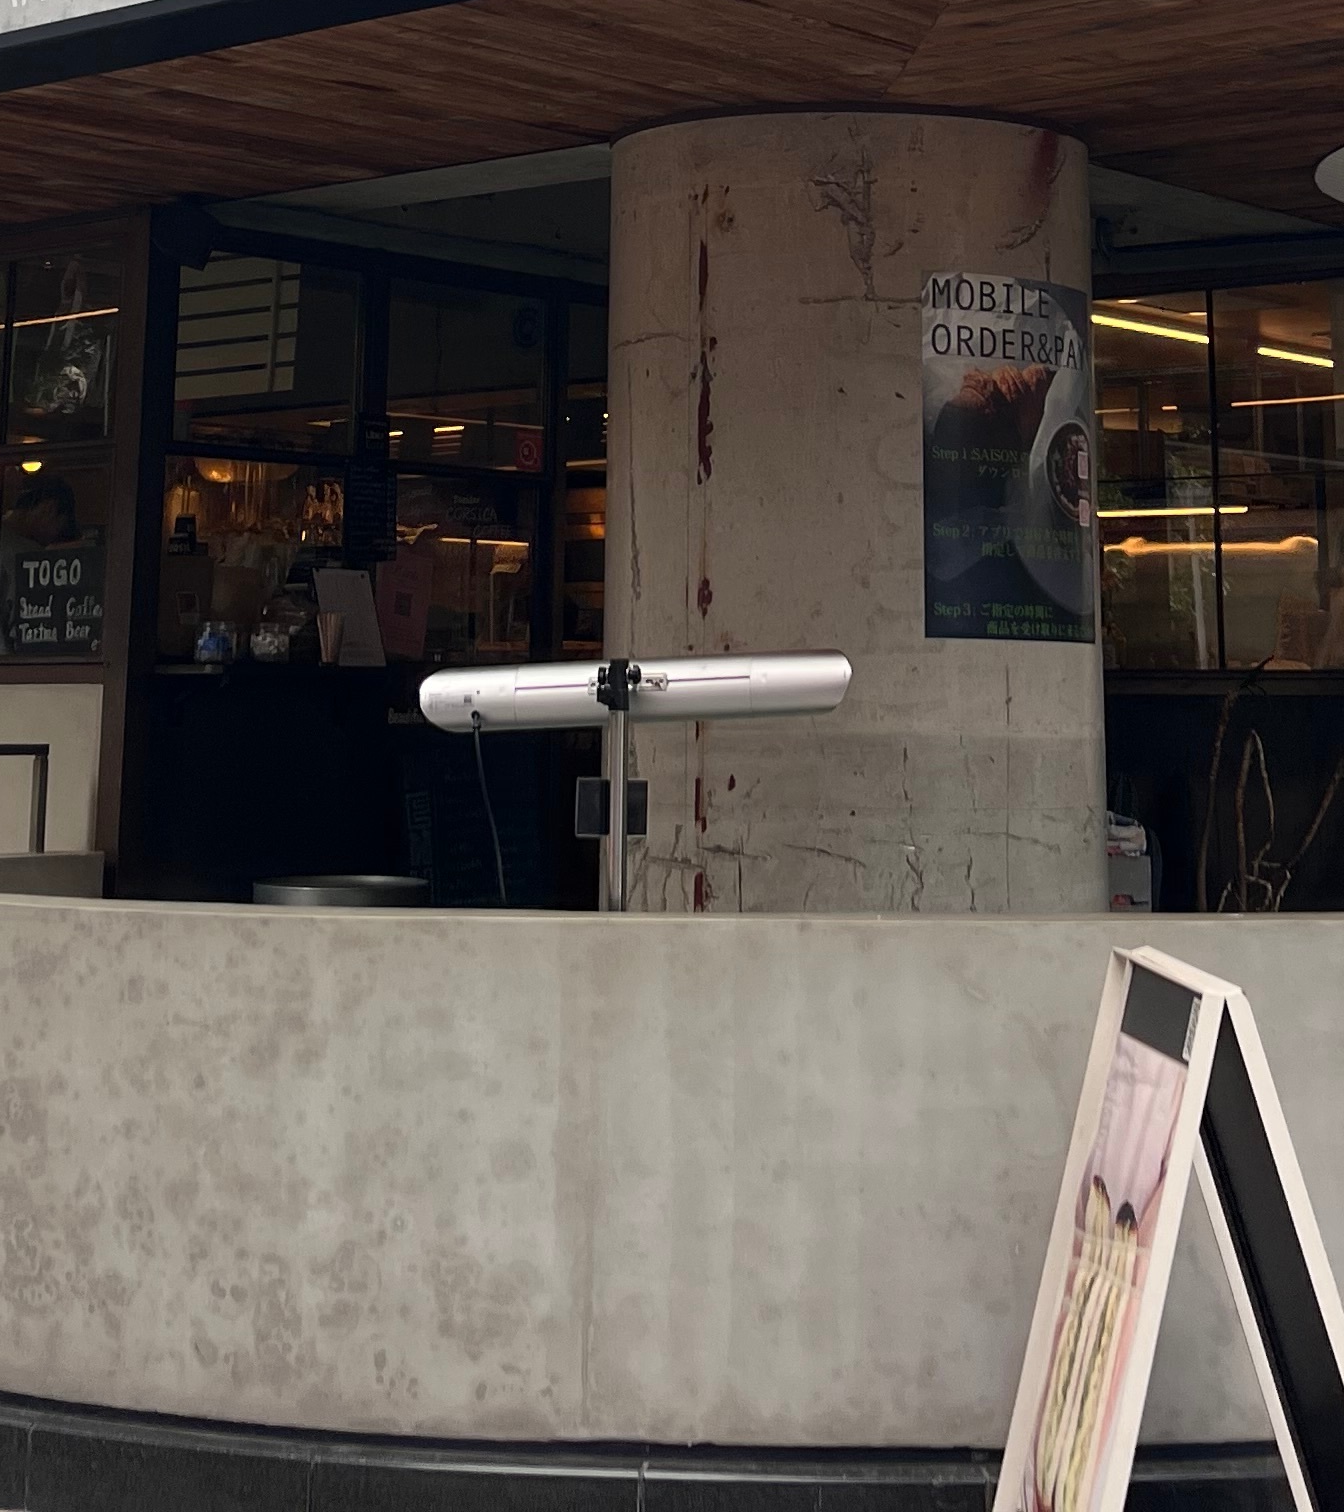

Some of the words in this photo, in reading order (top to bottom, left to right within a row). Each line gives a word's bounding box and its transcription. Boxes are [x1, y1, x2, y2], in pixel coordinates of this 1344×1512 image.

[932, 278, 1050, 319] MOBILE
[931, 444, 959, 462] Step
[932, 523, 960, 538] Step
[22, 558, 82, 588] TOGO
[933, 601, 961, 618] Step
